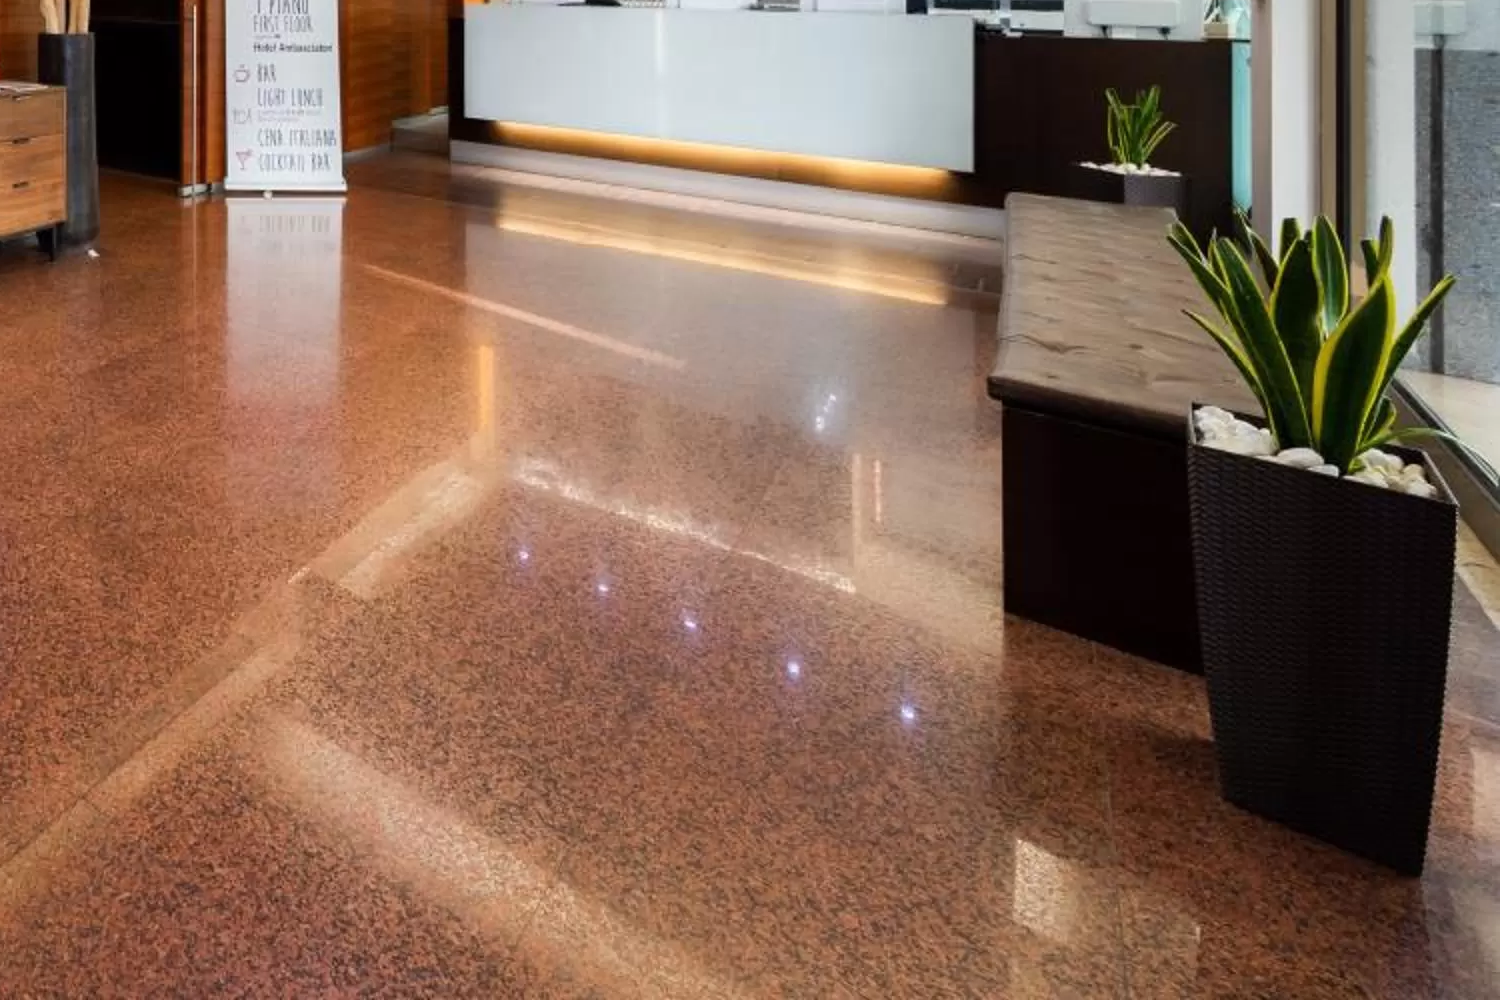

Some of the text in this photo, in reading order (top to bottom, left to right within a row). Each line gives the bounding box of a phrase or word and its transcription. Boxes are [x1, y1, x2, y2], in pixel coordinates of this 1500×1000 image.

[253, 15, 313, 33] FIRST FLOOR
[257, 63, 276, 83] BAR
[257, 87, 323, 108] LIGHT LUNCH
[310, 152, 331, 172] BAR
